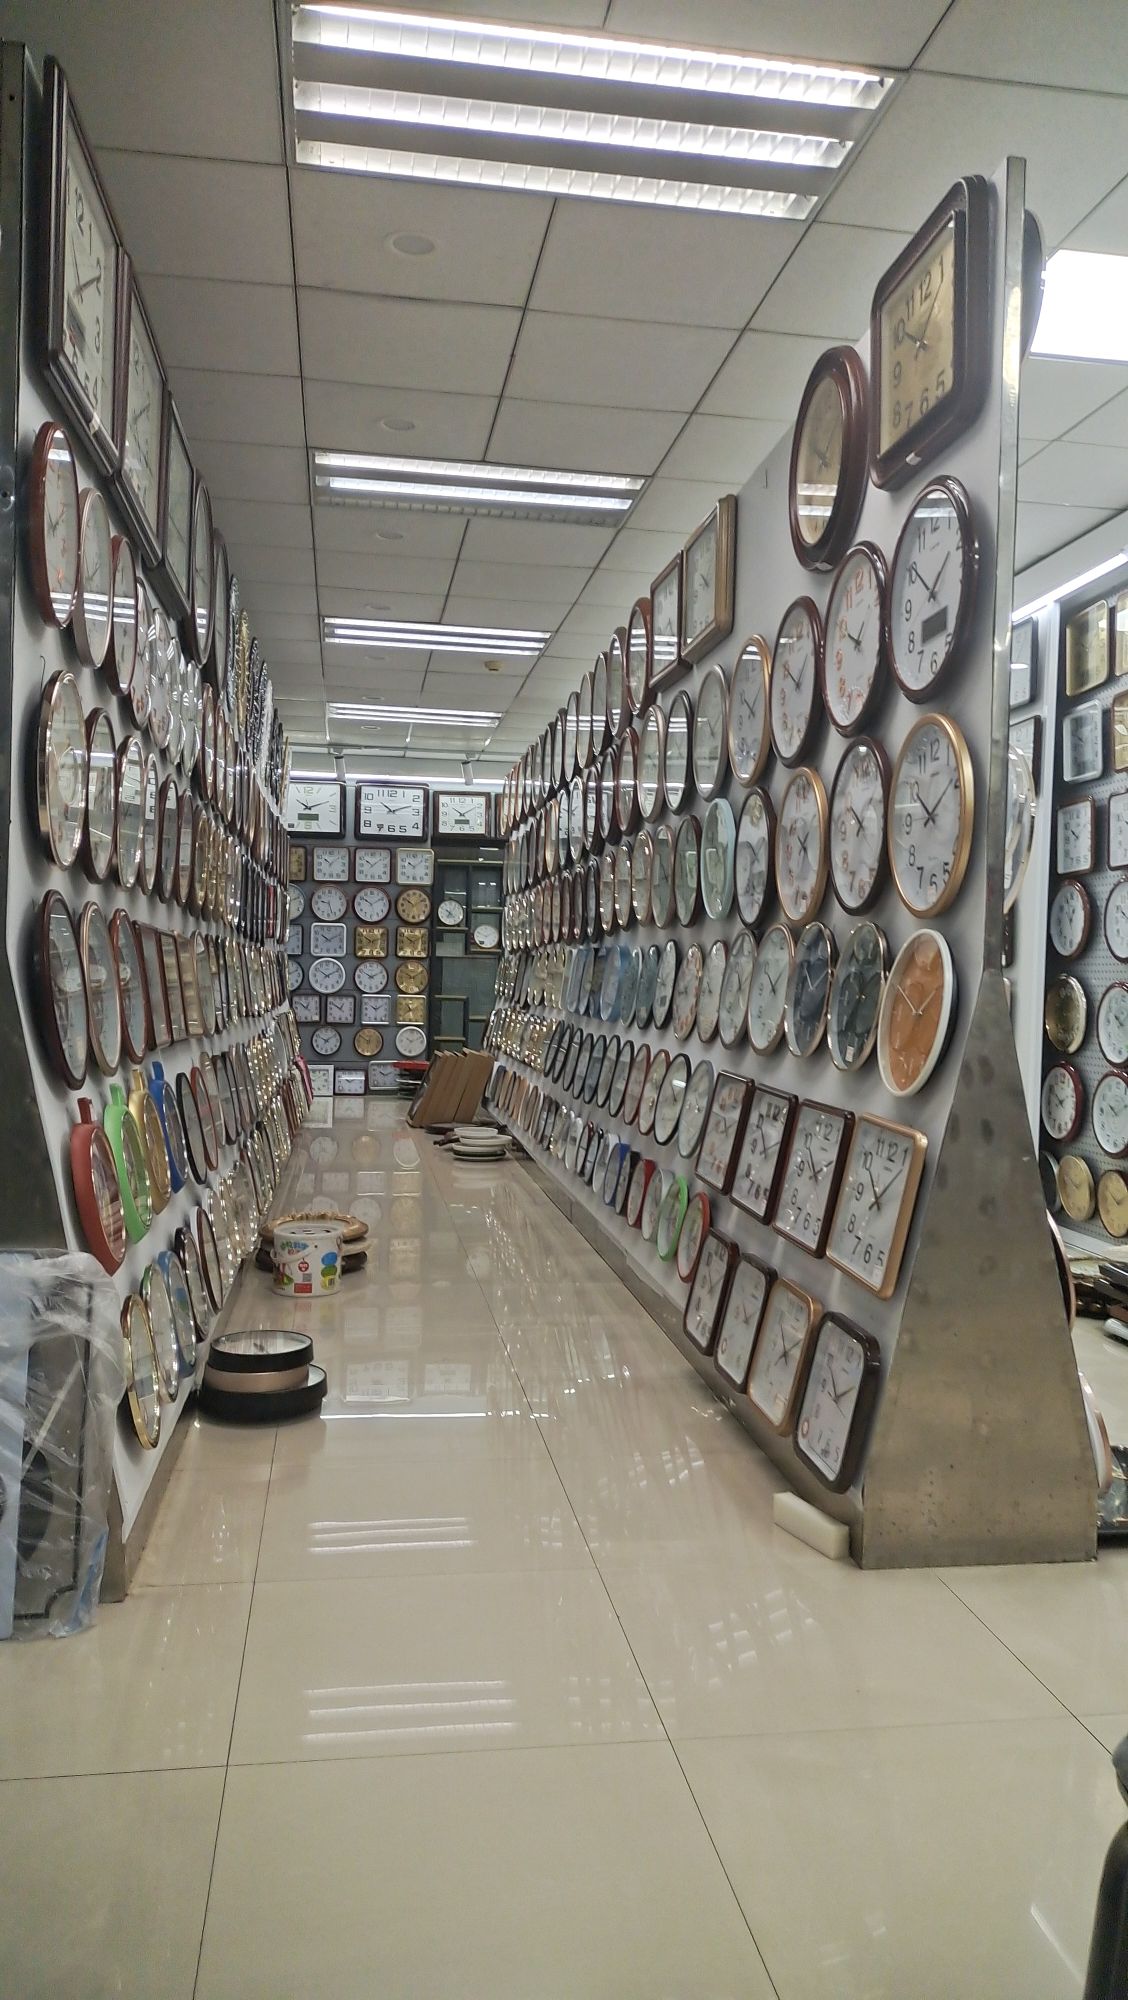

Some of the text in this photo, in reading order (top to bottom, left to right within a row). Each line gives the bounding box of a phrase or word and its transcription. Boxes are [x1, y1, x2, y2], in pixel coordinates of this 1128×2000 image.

[920, 271, 932, 306] 12
[906, 288, 914, 321] 11
[94, 315, 101, 354] 3
[893, 317, 905, 350] 10
[893, 360, 902, 389] 9
[920, 388, 929, 417] 6
[892, 400, 901, 429] 8
[904, 400, 914, 429] 7
[917, 526, 926, 552] 11
[855, 568, 864, 594] 12
[906, 560, 918, 586] 10
[904, 598, 912, 622] 9
[907, 630, 915, 654] 8
[916, 648, 924, 674] 7
[930, 651, 938, 675] 6
[930, 737, 940, 763] 12
[946, 743, 950, 766] 1
[918, 752, 926, 774] 11
[304, 786, 314, 795] 12
[364, 792, 374, 800] 10
[377, 789, 385, 797] 11
[387, 790, 398, 798] 12
[412, 794, 420, 803] 2
[903, 779, 920, 803] 10
[364, 806, 372, 814] 9
[411, 808, 420, 816] 3
[363, 819, 372, 828] 8
[387, 824, 396, 833] 6
[398, 825, 407, 833] 5
[411, 822, 419, 830] 4
[904, 812, 913, 836] 9
[908, 844, 916, 867] 8
[849, 870, 857, 893] 7
[916, 866, 925, 889] 7
[942, 861, 951, 886] 5
[875, 1138, 885, 1157] 11
[887, 1142, 898, 1163] 12
[902, 1147, 909, 1166] 1
[796, 1159, 805, 1178] 9
[862, 1149, 873, 1171] 10
[790, 1186, 799, 1206] 8
[855, 1182, 865, 1202] 9
[794, 1206, 802, 1224] 7
[803, 1211, 812, 1231] 6
[847, 1213, 857, 1234] 8
[812, 1217, 822, 1236] 5
[852, 1234, 862, 1255] 7
[863, 1243, 873, 1264] 6
